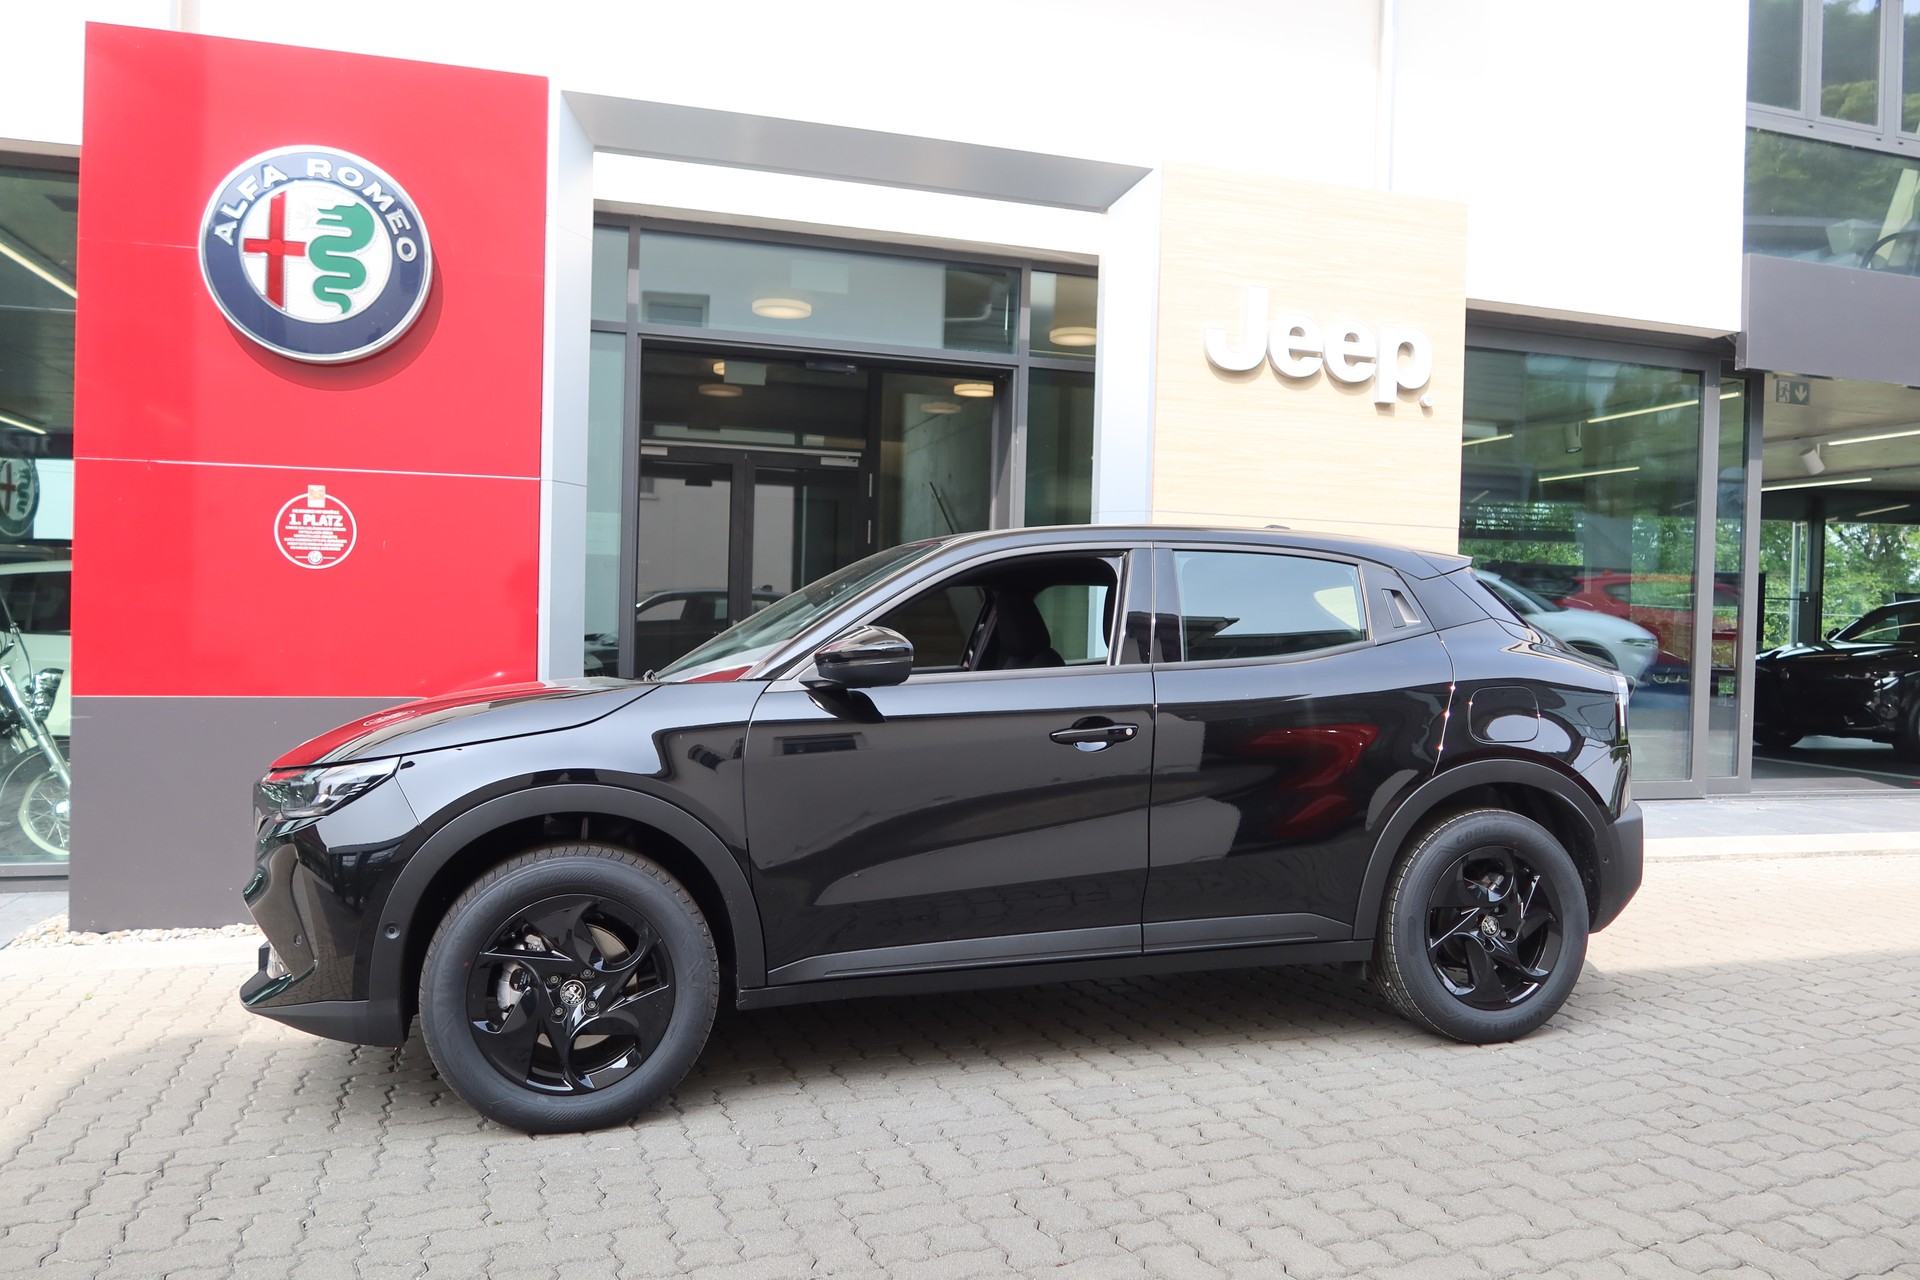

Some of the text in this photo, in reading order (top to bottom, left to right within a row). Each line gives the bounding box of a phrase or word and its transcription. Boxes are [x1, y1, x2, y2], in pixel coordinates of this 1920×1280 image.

[214, 157, 418, 263] ALFA ROMEO
[1203, 285, 1433, 404] Jeep
[288, 513, 344, 526] 1. PLATZ
